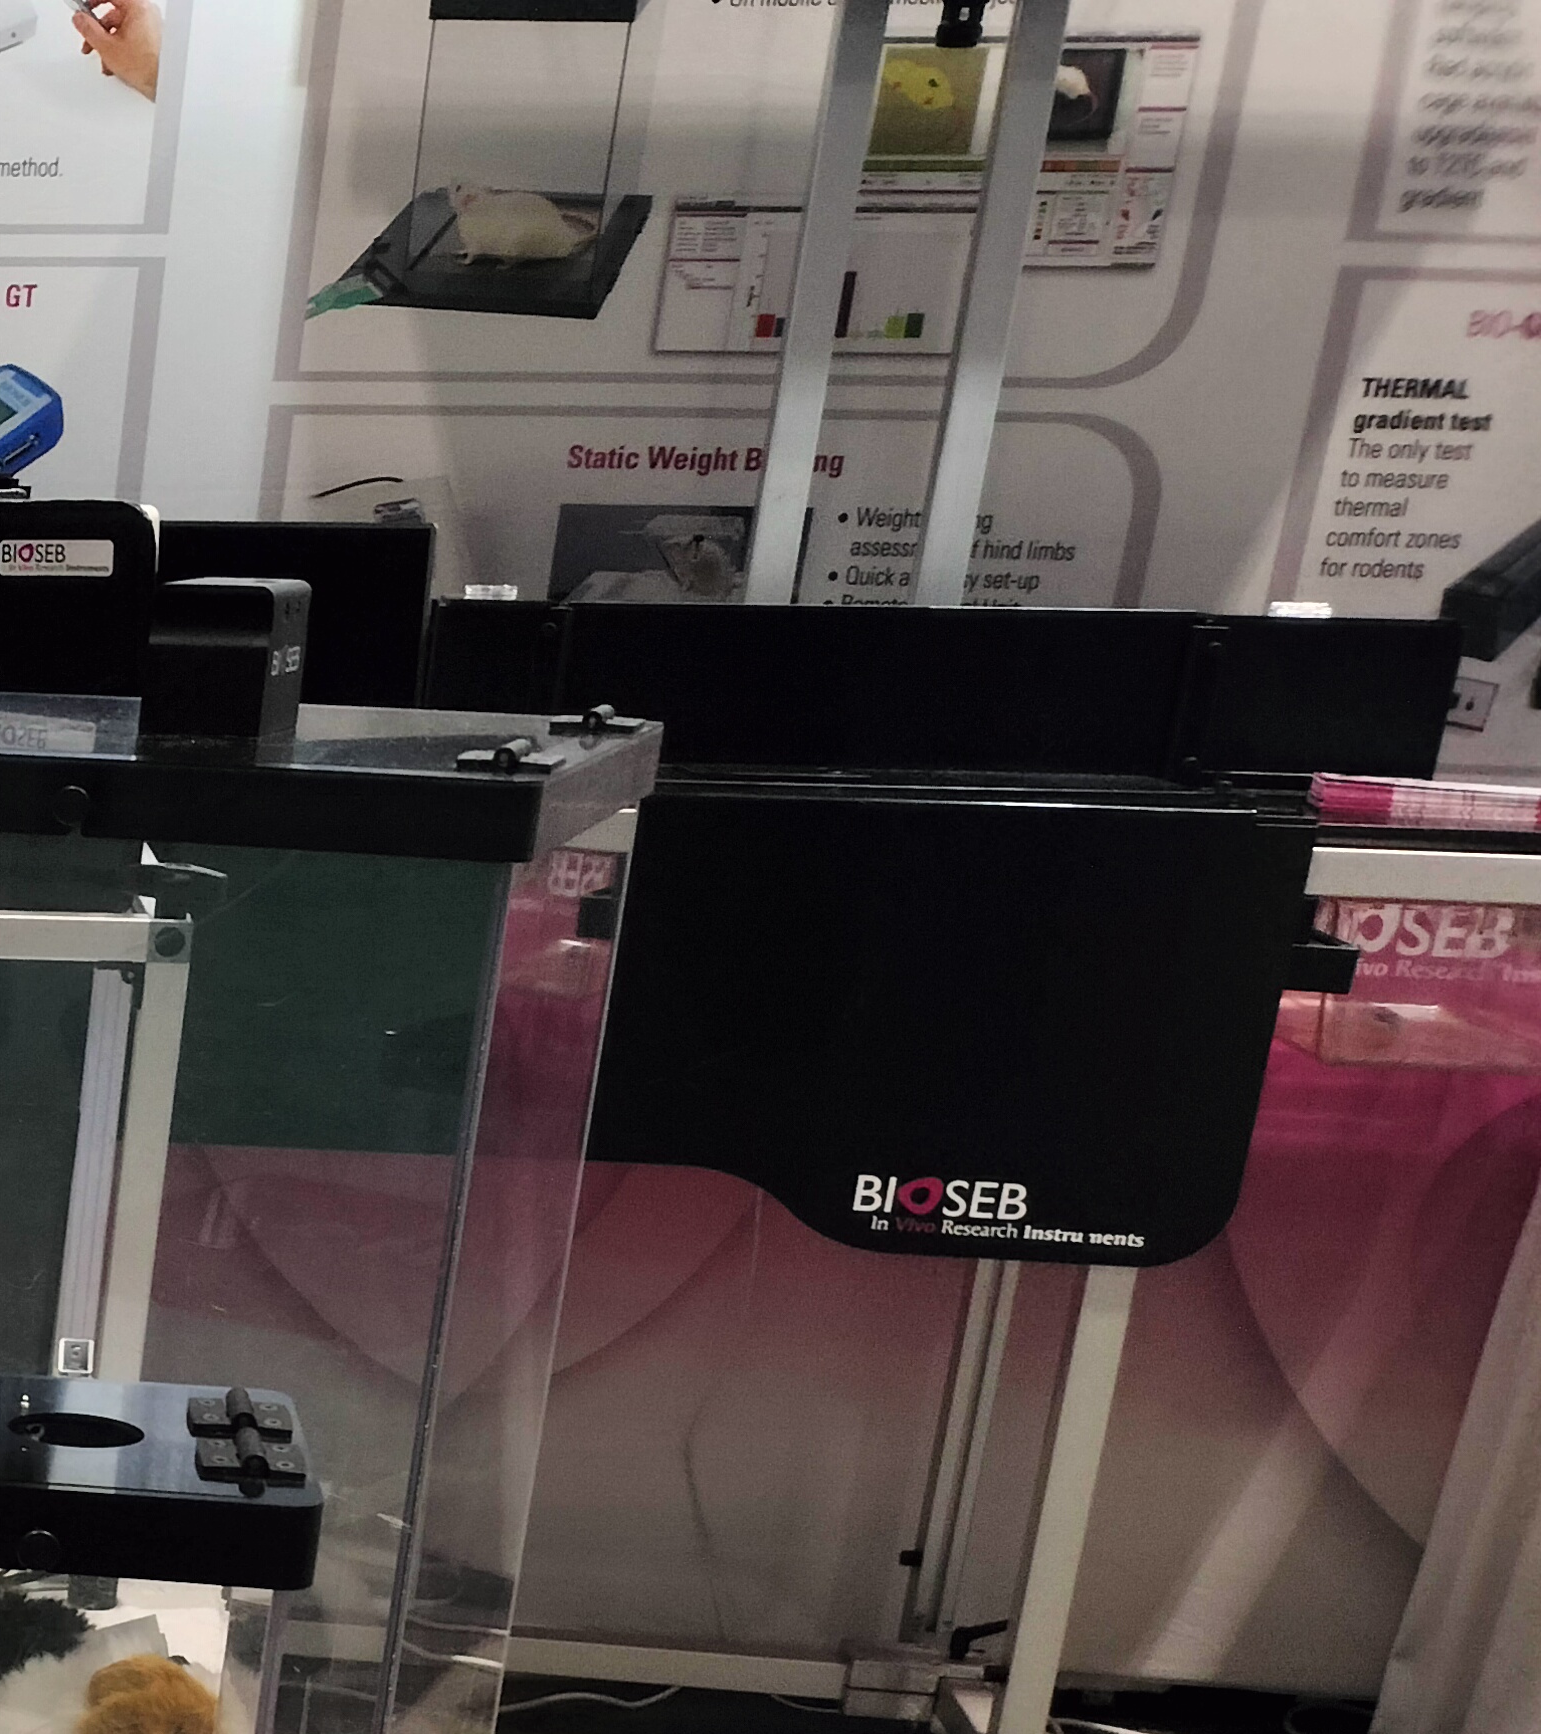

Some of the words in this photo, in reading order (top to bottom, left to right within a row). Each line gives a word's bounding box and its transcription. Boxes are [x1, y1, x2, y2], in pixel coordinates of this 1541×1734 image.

[6, 284, 38, 308] GT
[1362, 377, 1470, 400] THERMAL
[1353, 409, 1445, 433] gradient
[1450, 413, 1493, 432] test
[568, 444, 639, 469] Static
[648, 446, 739, 476] Weight
[1349, 437, 1382, 459] The
[1388, 440, 1430, 463] only
[1434, 442, 1474, 461] test
[1340, 469, 1360, 488] to
[1364, 472, 1449, 490] measure
[1334, 497, 1409, 517] thermal
[1326, 527, 1402, 547] comfort
[1405, 533, 1462, 550] zones
[1, 543, 66, 563] BIOSEB
[983, 540, 1023, 560] hind
[1027, 541, 1075, 562] limbs
[846, 565, 893, 586] Quick
[1320, 557, 1347, 578] for
[1350, 558, 1424, 579] rodents
[983, 571, 1040, 593] set-up
[852, 1174, 1028, 1221] BIOSEB
[870, 1215, 889, 1231] In
[895, 1217, 936, 1233] Vivo
[941, 1219, 1018, 1239] Research
